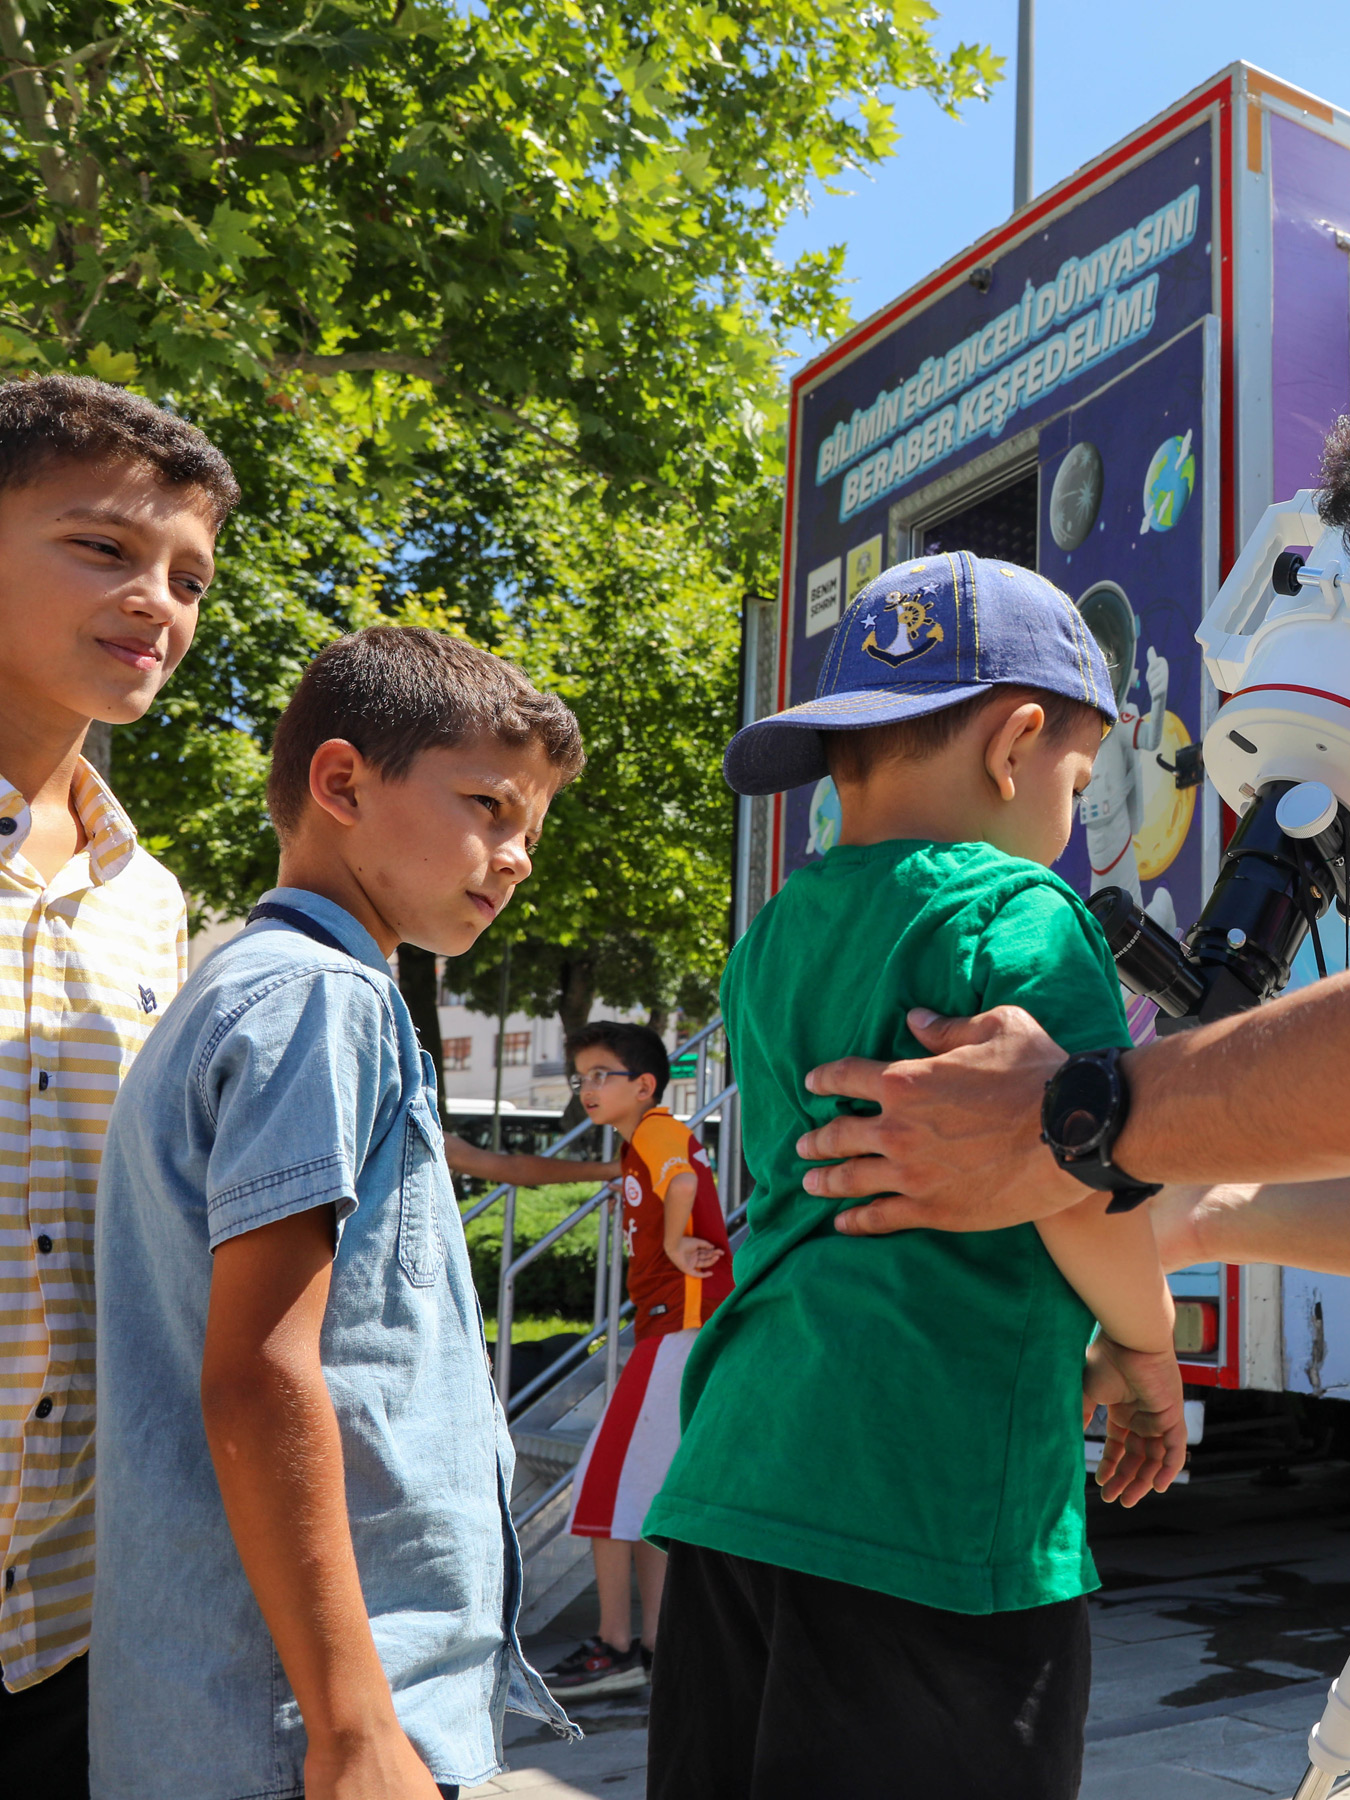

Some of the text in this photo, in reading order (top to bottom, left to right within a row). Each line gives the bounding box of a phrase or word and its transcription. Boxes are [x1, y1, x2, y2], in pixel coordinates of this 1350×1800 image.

[820, 193, 1196, 478] BİLİMİN EĞLENCELİ DÜNYASINI
[844, 281, 1156, 514] BERABER KEŞFEDELİM!
